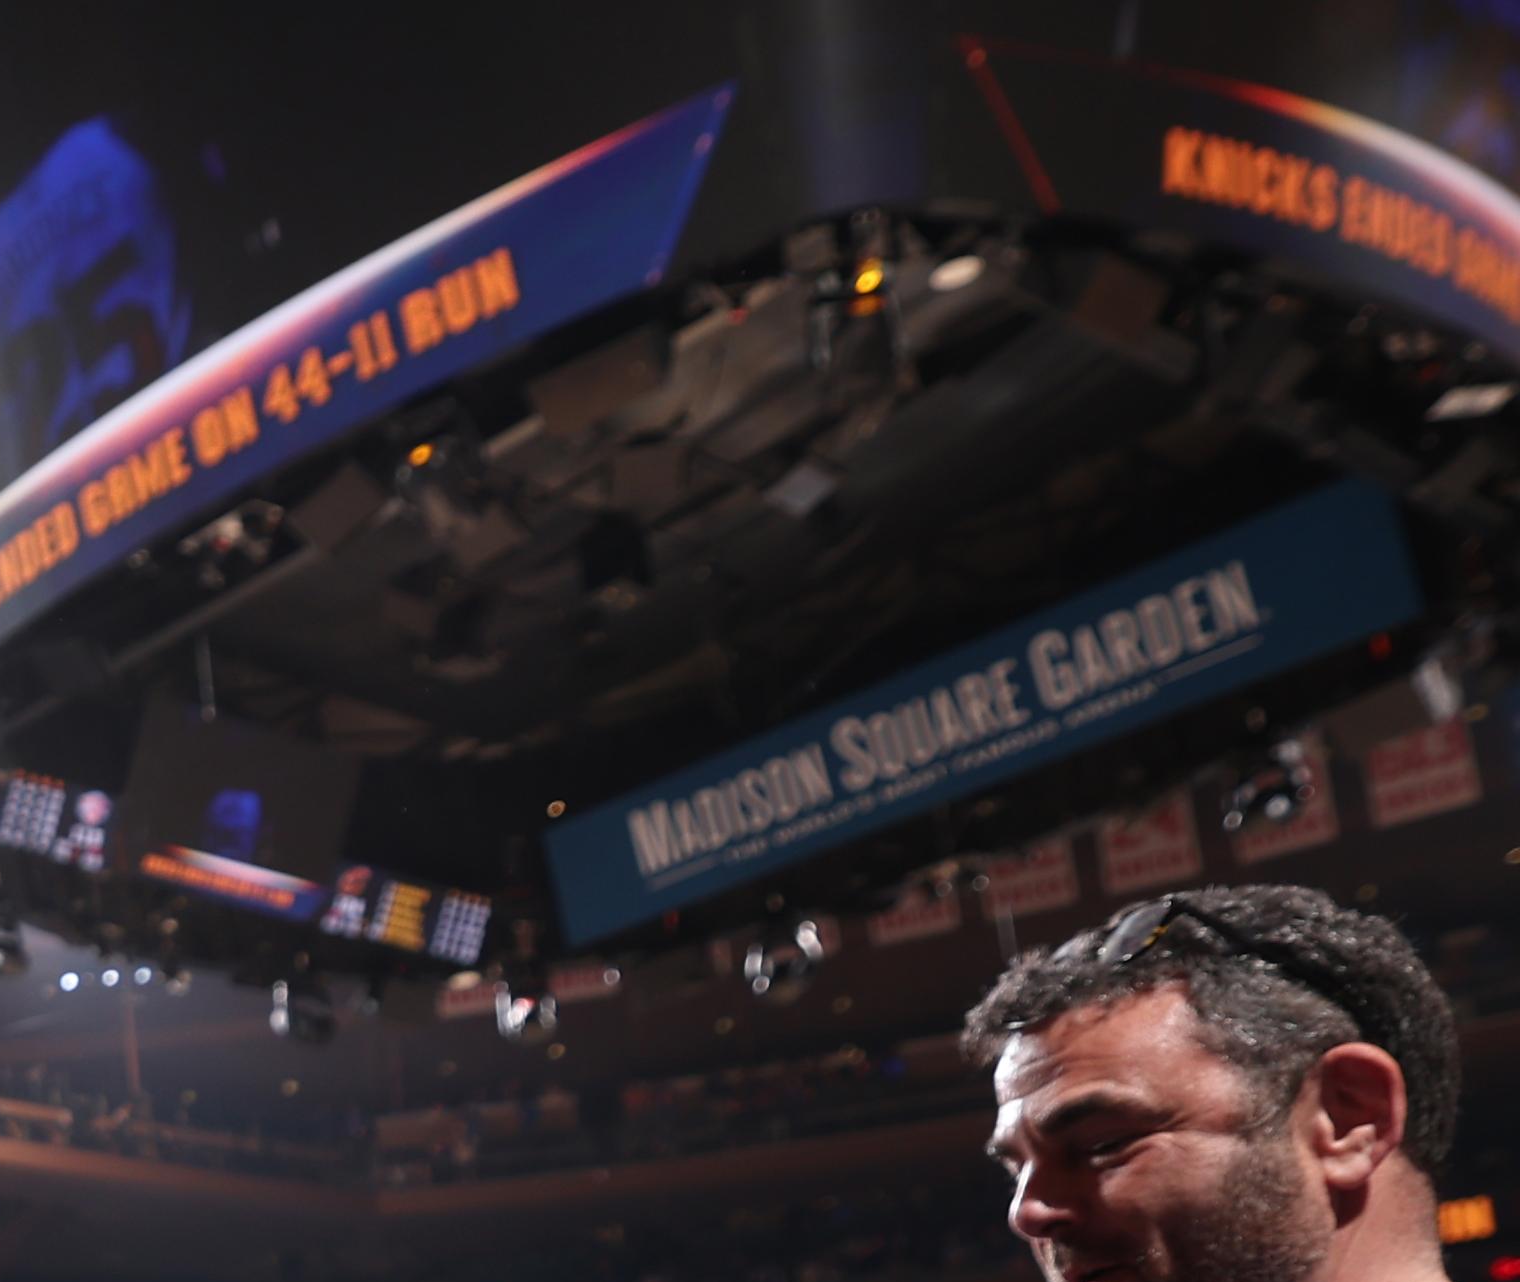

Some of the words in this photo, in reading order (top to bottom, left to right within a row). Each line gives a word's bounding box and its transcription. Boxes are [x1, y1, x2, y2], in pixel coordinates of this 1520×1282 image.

[1163, 126, 1338, 232] KNICKS
[78, 425, 192, 537] GAME
[191, 386, 260, 468] ON
[262, 310, 398, 425] 44-11
[399, 246, 520, 356] RUN
[627, 743, 834, 877] MADISON
[829, 656, 1032, 791] SQUARE
[1027, 560, 1260, 711] GARDEN
